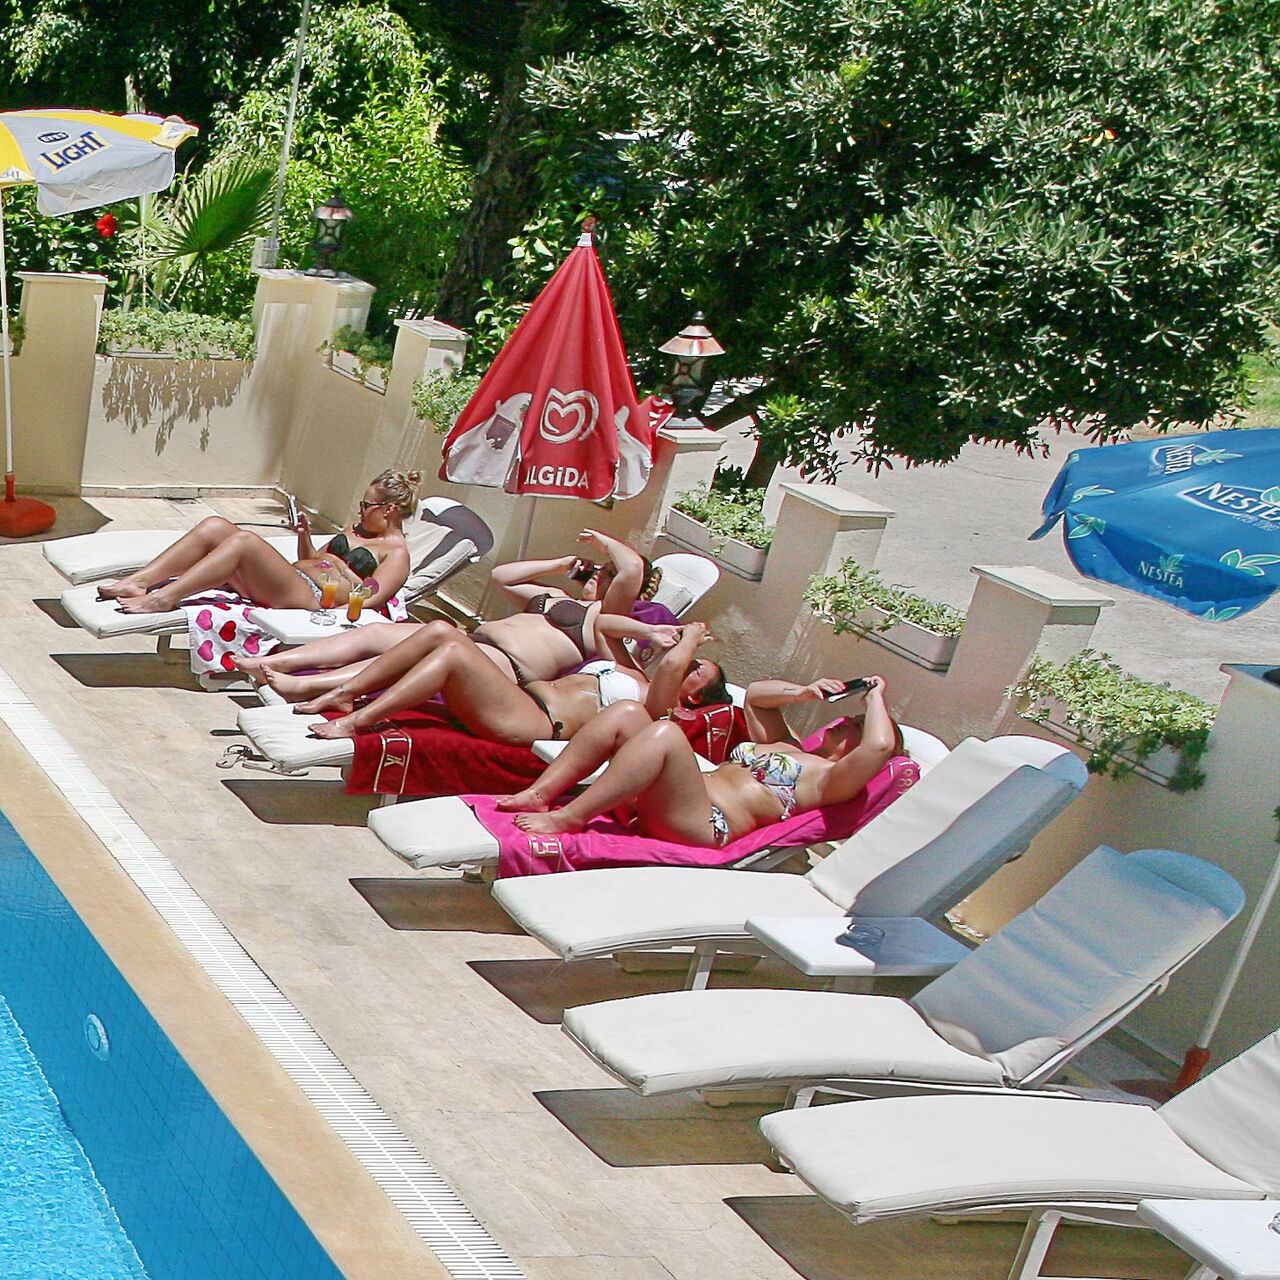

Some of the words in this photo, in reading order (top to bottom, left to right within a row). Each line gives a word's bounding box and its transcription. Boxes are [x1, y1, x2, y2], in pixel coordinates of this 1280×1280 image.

[40, 131, 105, 170] LIGHT
[1165, 443, 1195, 475] NESTEA
[1196, 482, 1280, 522] NESTE
[1138, 560, 1183, 589] NESTEA
